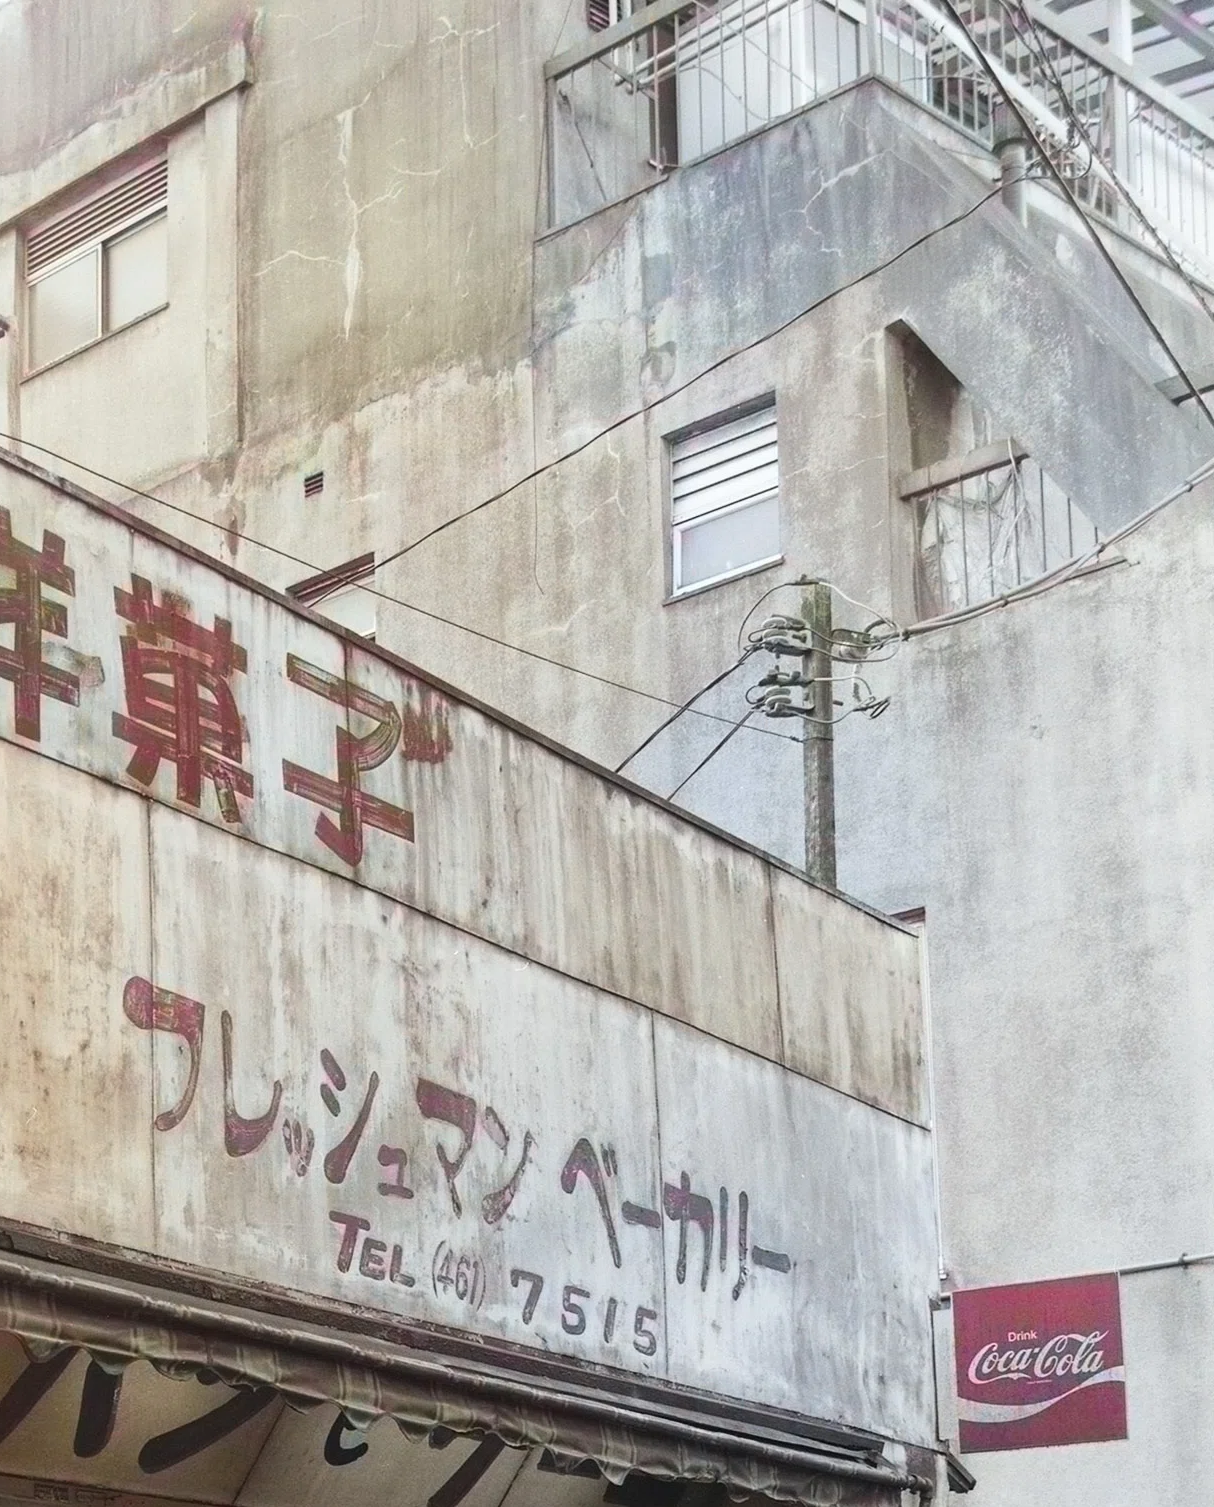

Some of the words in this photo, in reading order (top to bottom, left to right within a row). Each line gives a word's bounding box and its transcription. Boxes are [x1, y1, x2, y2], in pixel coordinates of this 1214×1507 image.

[329, 1211, 416, 1288] TEL
[431, 1240, 487, 1312] (461)
[511, 1270, 658, 1357] 7515
[968, 1329, 1110, 1385] Coca-Cola
[1007, 1330, 1038, 1342] Drink
